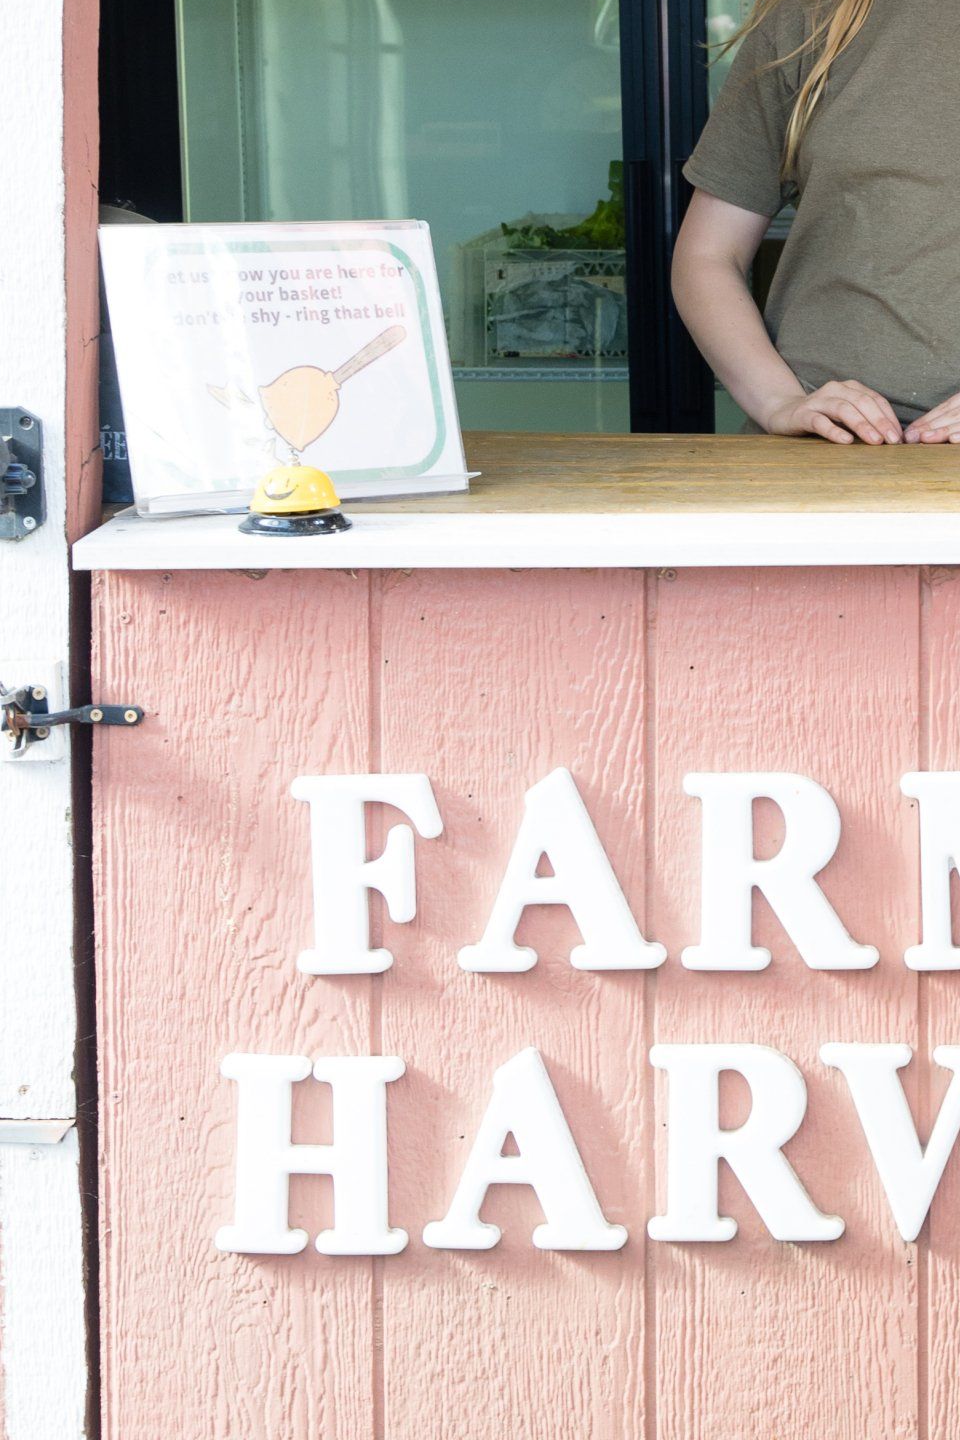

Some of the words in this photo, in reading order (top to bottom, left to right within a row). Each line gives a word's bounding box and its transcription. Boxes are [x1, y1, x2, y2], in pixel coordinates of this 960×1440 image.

[189, 270, 210, 284] us
[268, 268, 300, 286] you
[305, 267, 333, 281] are
[336, 264, 375, 280] here
[380, 262, 405, 279] for
[278, 285, 342, 303] basket!
[250, 307, 280, 327] shy
[296, 305, 331, 325] ring
[334, 304, 371, 320] that
[374, 302, 406, 319] bell
